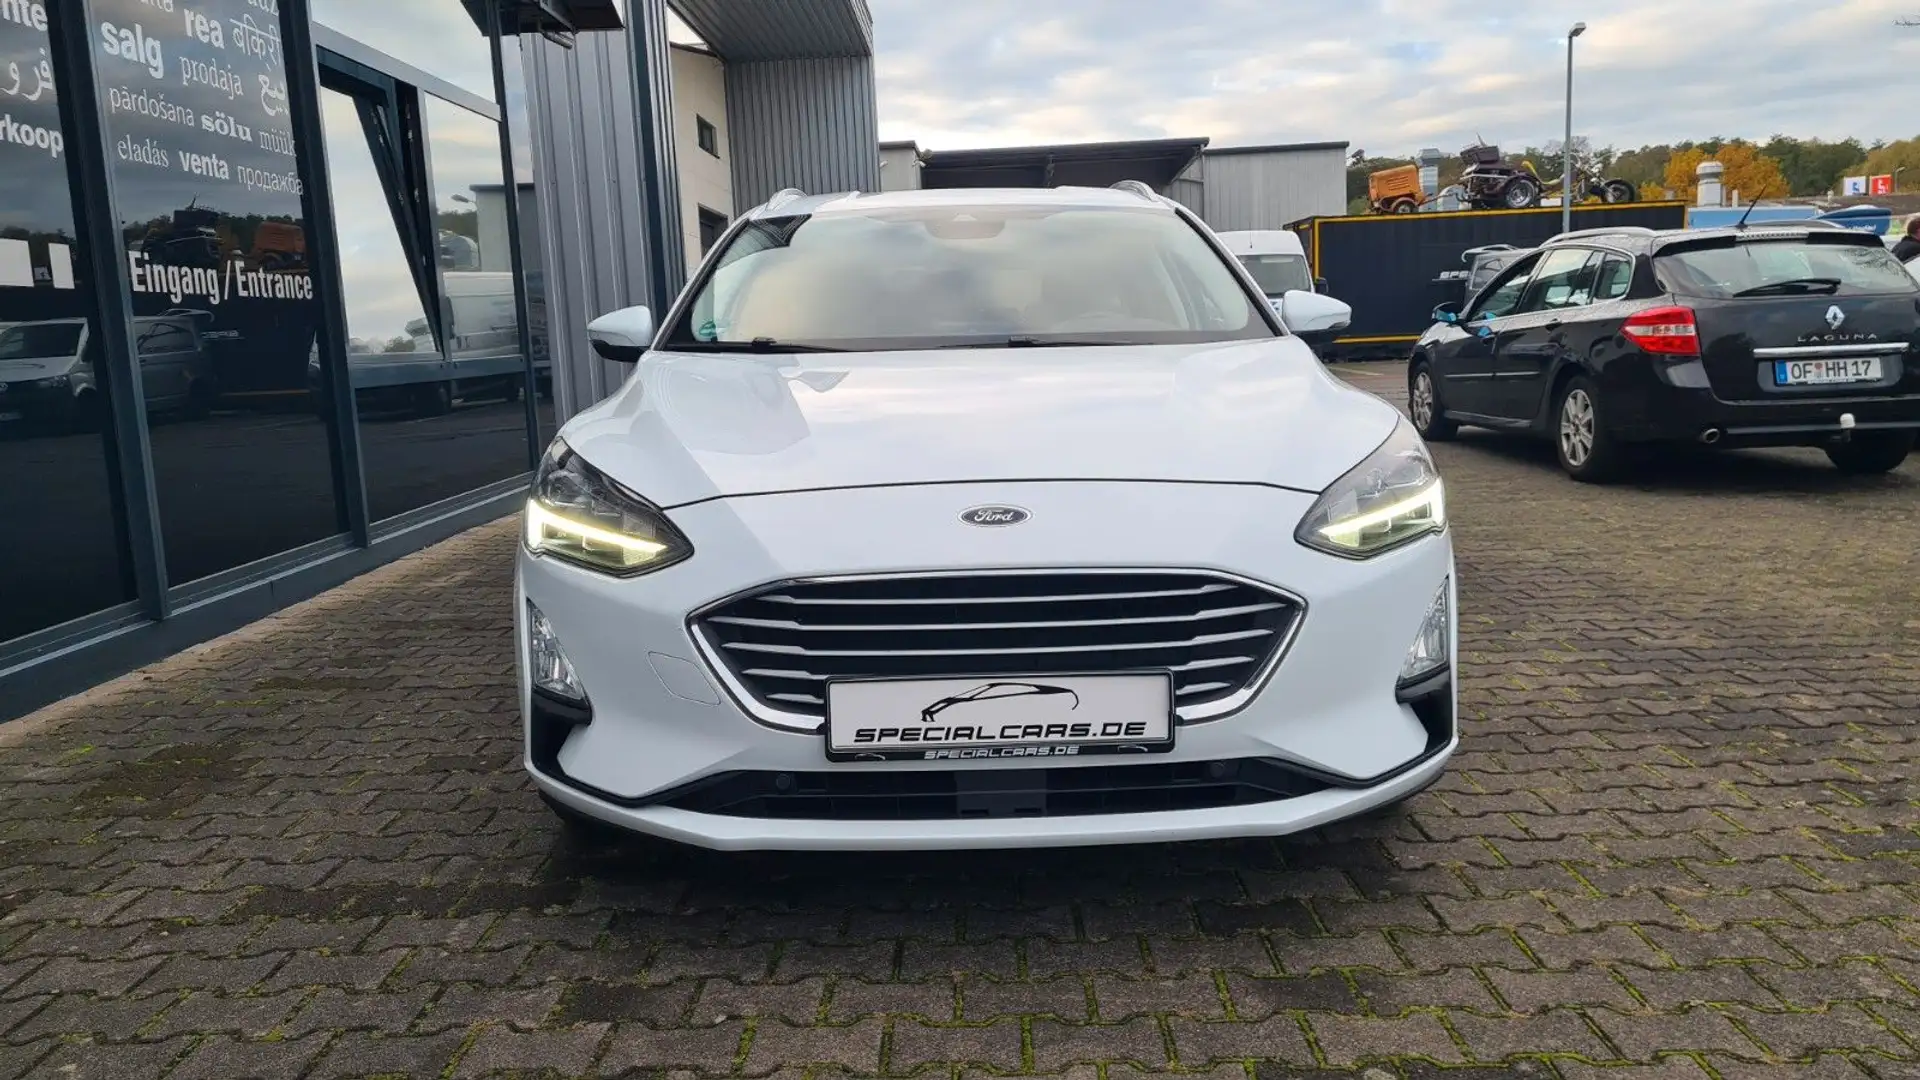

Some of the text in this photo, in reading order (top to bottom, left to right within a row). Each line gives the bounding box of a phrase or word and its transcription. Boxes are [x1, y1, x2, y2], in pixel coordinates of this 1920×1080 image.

[101, 21, 164, 79] salg
[184, 9, 225, 50] rea
[179, 57, 244, 101] prodaja
[201, 110, 253, 142] sölu
[117, 134, 230, 181] eladás venta
[237, 165, 304, 196] продажба
[1797, 333, 1877, 342] LAGUNA
[1791, 360, 1872, 379] OF HH 17
[974, 507, 1014, 521] Ford
[853, 721, 1148, 744] SPECIALCARS.DE
[923, 745, 1080, 760] SPECIALCARS.DE
